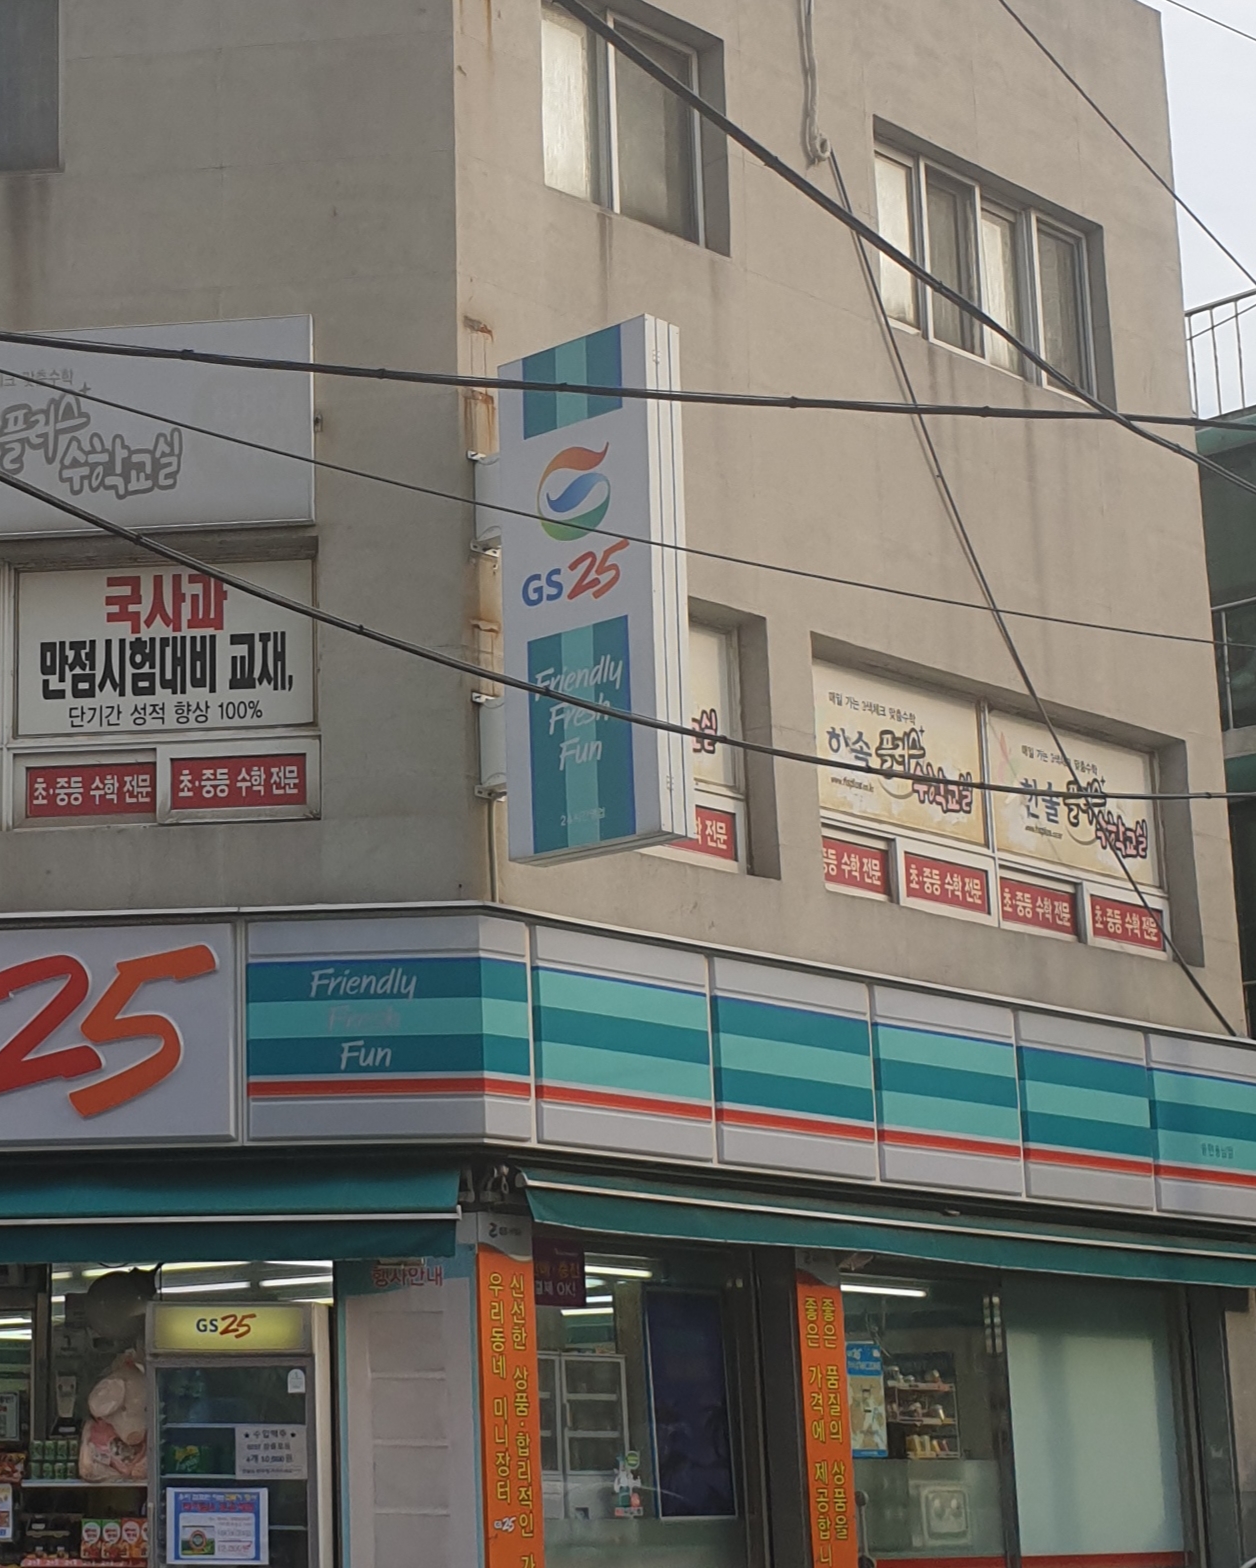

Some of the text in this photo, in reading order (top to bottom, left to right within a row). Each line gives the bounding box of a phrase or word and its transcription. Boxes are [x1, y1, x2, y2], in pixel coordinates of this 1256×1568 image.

[58, 427, 183, 500] 수학교실
[522, 538, 630, 607] GS25
[105, 573, 228, 634] 국사과
[40, 631, 293, 699] 만점시험대비 교재,
[534, 654, 623, 701] Friendly
[69, 700, 263, 728] 단기간 성적 향상 100%
[549, 692, 611, 735] Fresh
[559, 739, 602, 771] Fun
[32, 774, 151, 806] 초·중등 수학 전문
[178, 765, 299, 798] 초·중등 수학 전문
[705, 821, 727, 849] 전문
[841, 851, 881, 886] 수학 전문
[944, 872, 963, 900] 수학
[964, 876, 982, 905] 전문
[1035, 896, 1052, 923] 수학
[1054, 900, 1071, 927] 전문
[1125, 912, 1141, 938] 수학
[310, 967, 417, 1003] Friendly
[340, 1040, 393, 1071] Fun
[556, 1281, 576, 1297] OK!
[196, 1313, 256, 1339] GS25
[510, 1274, 527, 1350] 신선한
[488, 1275, 511, 1503] 우리동네 미니장터
[805, 1297, 832, 1567] 좋은 가격에 제공합니
[821, 1298, 848, 1540] 좋은 품질의 상품을
